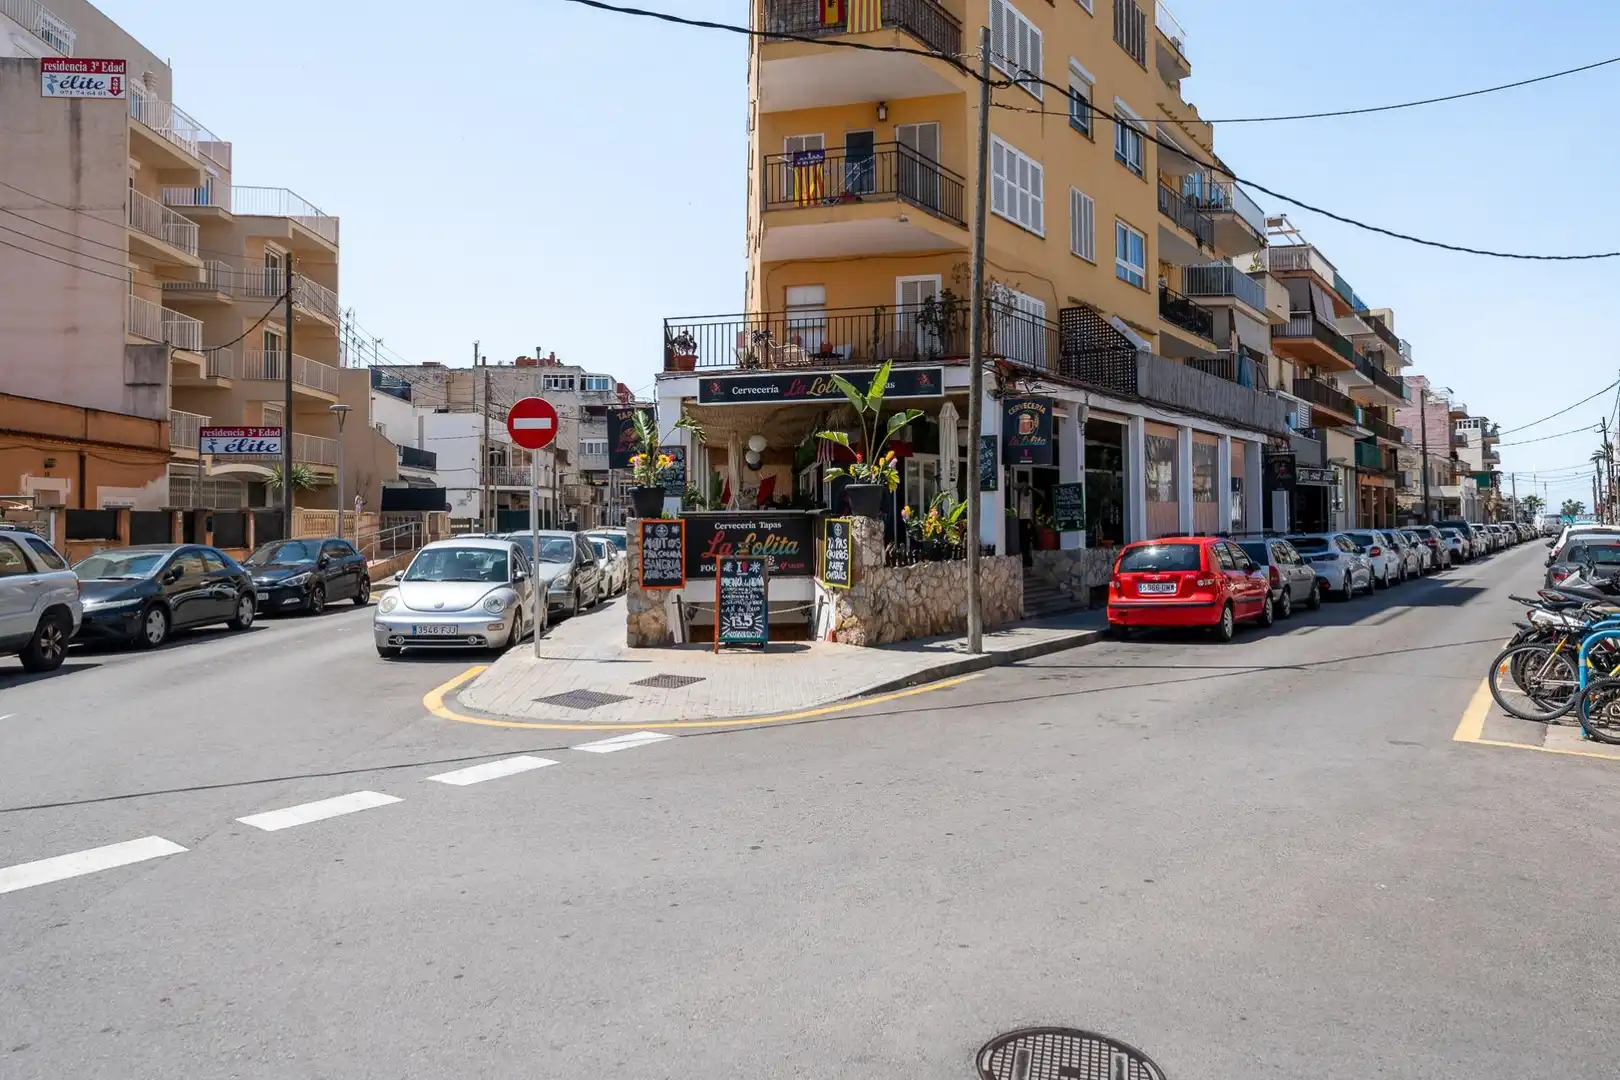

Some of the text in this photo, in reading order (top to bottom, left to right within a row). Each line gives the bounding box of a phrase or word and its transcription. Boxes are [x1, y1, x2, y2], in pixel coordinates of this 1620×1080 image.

[43, 60, 88, 72] residencia
[101, 61, 125, 73] Edad
[60, 75, 105, 90] élite
[731, 384, 779, 396] Cervecería
[783, 378, 806, 396] La
[202, 428, 245, 437] residencia
[258, 428, 281, 437] Edad
[224, 438, 279, 452] élite
[714, 520, 782, 530] Cervecería Tapas
[701, 530, 800, 558] La Lolita
[418, 626, 439, 634] 3546
